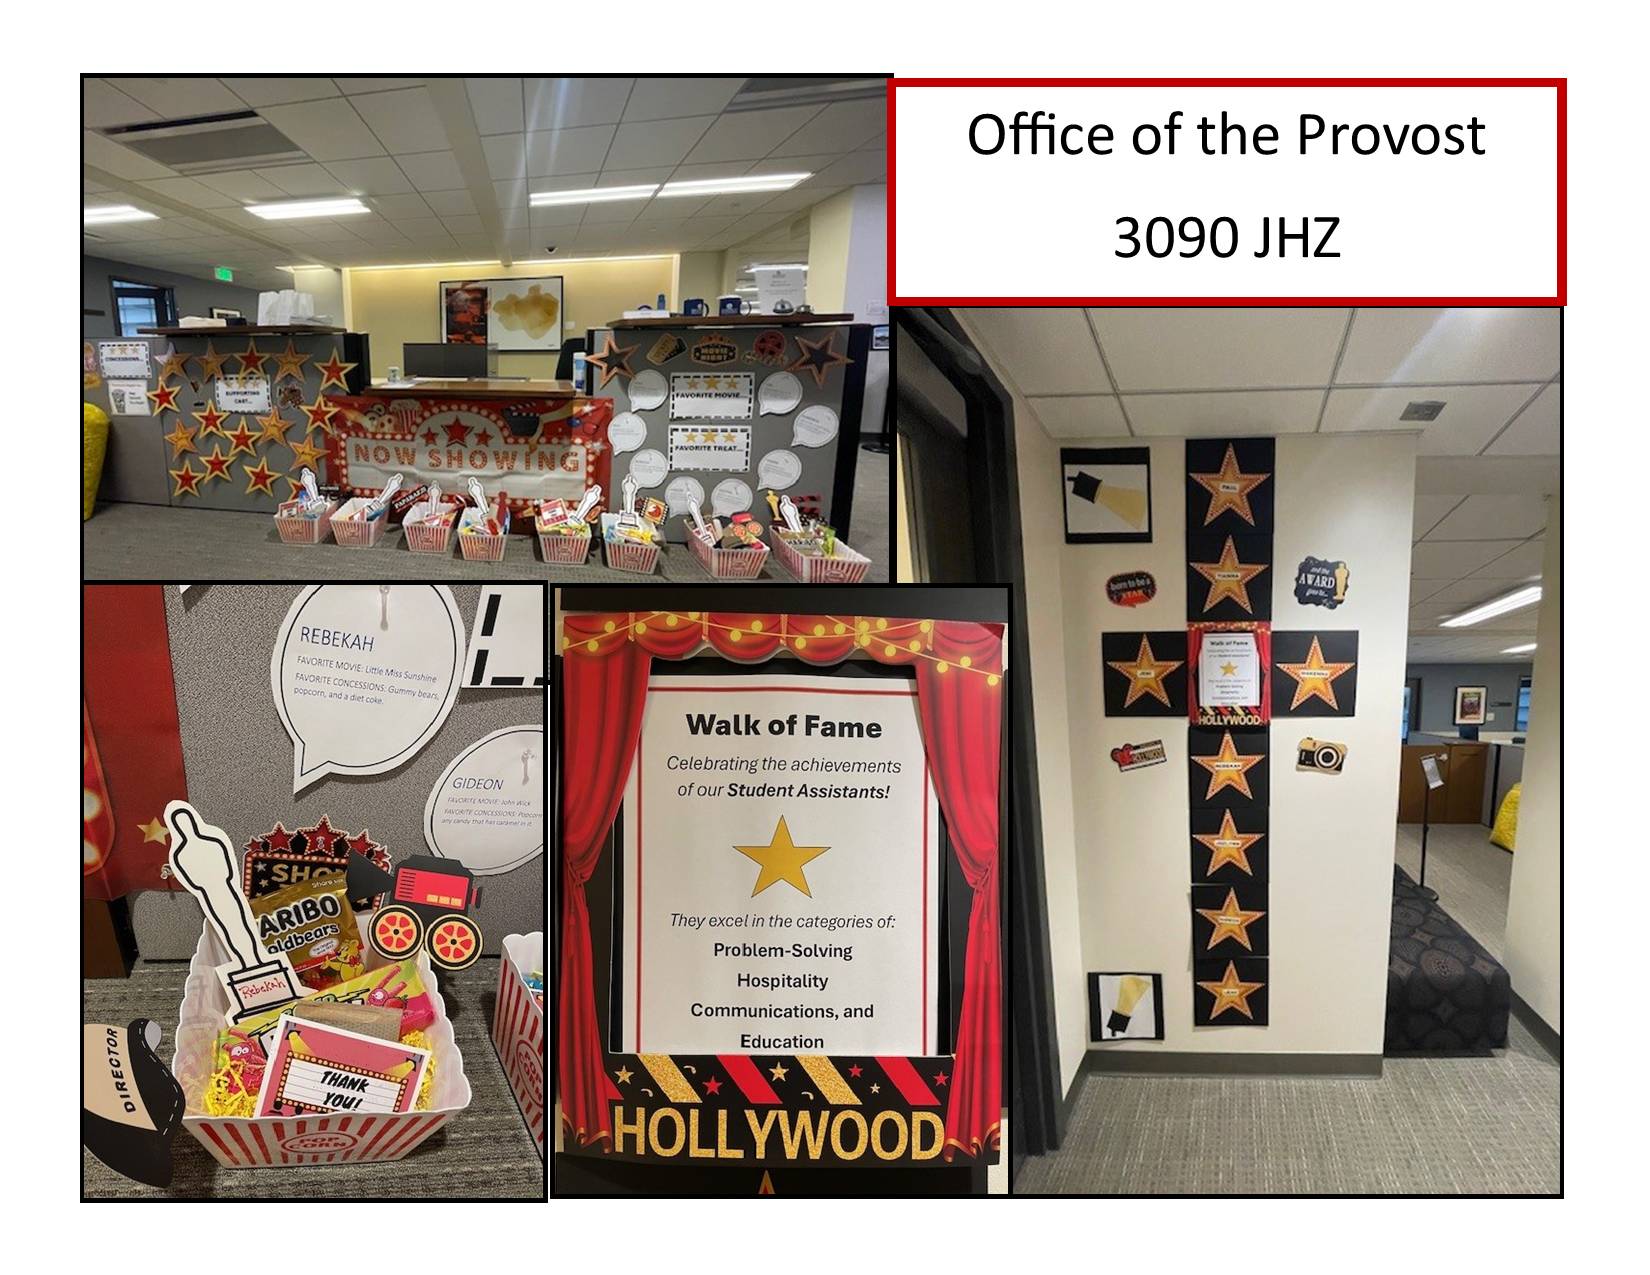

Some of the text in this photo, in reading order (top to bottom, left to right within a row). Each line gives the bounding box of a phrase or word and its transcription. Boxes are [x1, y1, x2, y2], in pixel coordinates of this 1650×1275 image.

[354, 443, 579, 473] NOW SHOWING
[1299, 573, 1335, 589] AWARD
[300, 626, 375, 652] REBEKAH
[297, 655, 438, 683] FAVORITE MOVIE: Little Miss Sunshine
[293, 687, 327, 698] popcorn,
[329, 692, 343, 700] and
[350, 694, 365, 702] diet
[366, 695, 384, 704] coke.
[294, 672, 440, 701] FAVORITE CONCESSIONS: Gummy bears,
[686, 713, 882, 738] Walk of Fame
[1199, 714, 1261, 725] HOLLYWOOD
[667, 755, 902, 774] Celebrating the achievements
[453, 777, 504, 790] GIDEON
[677, 782, 891, 800] of our Student Assistants!
[444, 808, 472, 816] FAVORITE
[311, 879, 332, 889] Share
[260, 895, 339, 938] ARIBO
[670, 913, 896, 931] They excel in the categories of:
[267, 924, 339, 955] oldbears
[713, 942, 853, 962] Problem-Solving
[238, 977, 287, 1000] Rebekah
[737, 973, 829, 991] Hospitality
[690, 1003, 875, 1021] Communications, and
[740, 1033, 825, 1050] Education
[106, 1028, 136, 1113] DIRECTOR
[320, 1070, 370, 1093] THANK
[322, 1091, 364, 1112] YOU!
[300, 1136, 340, 1144] POP
[613, 1104, 945, 1161] HOLLYWOOD
